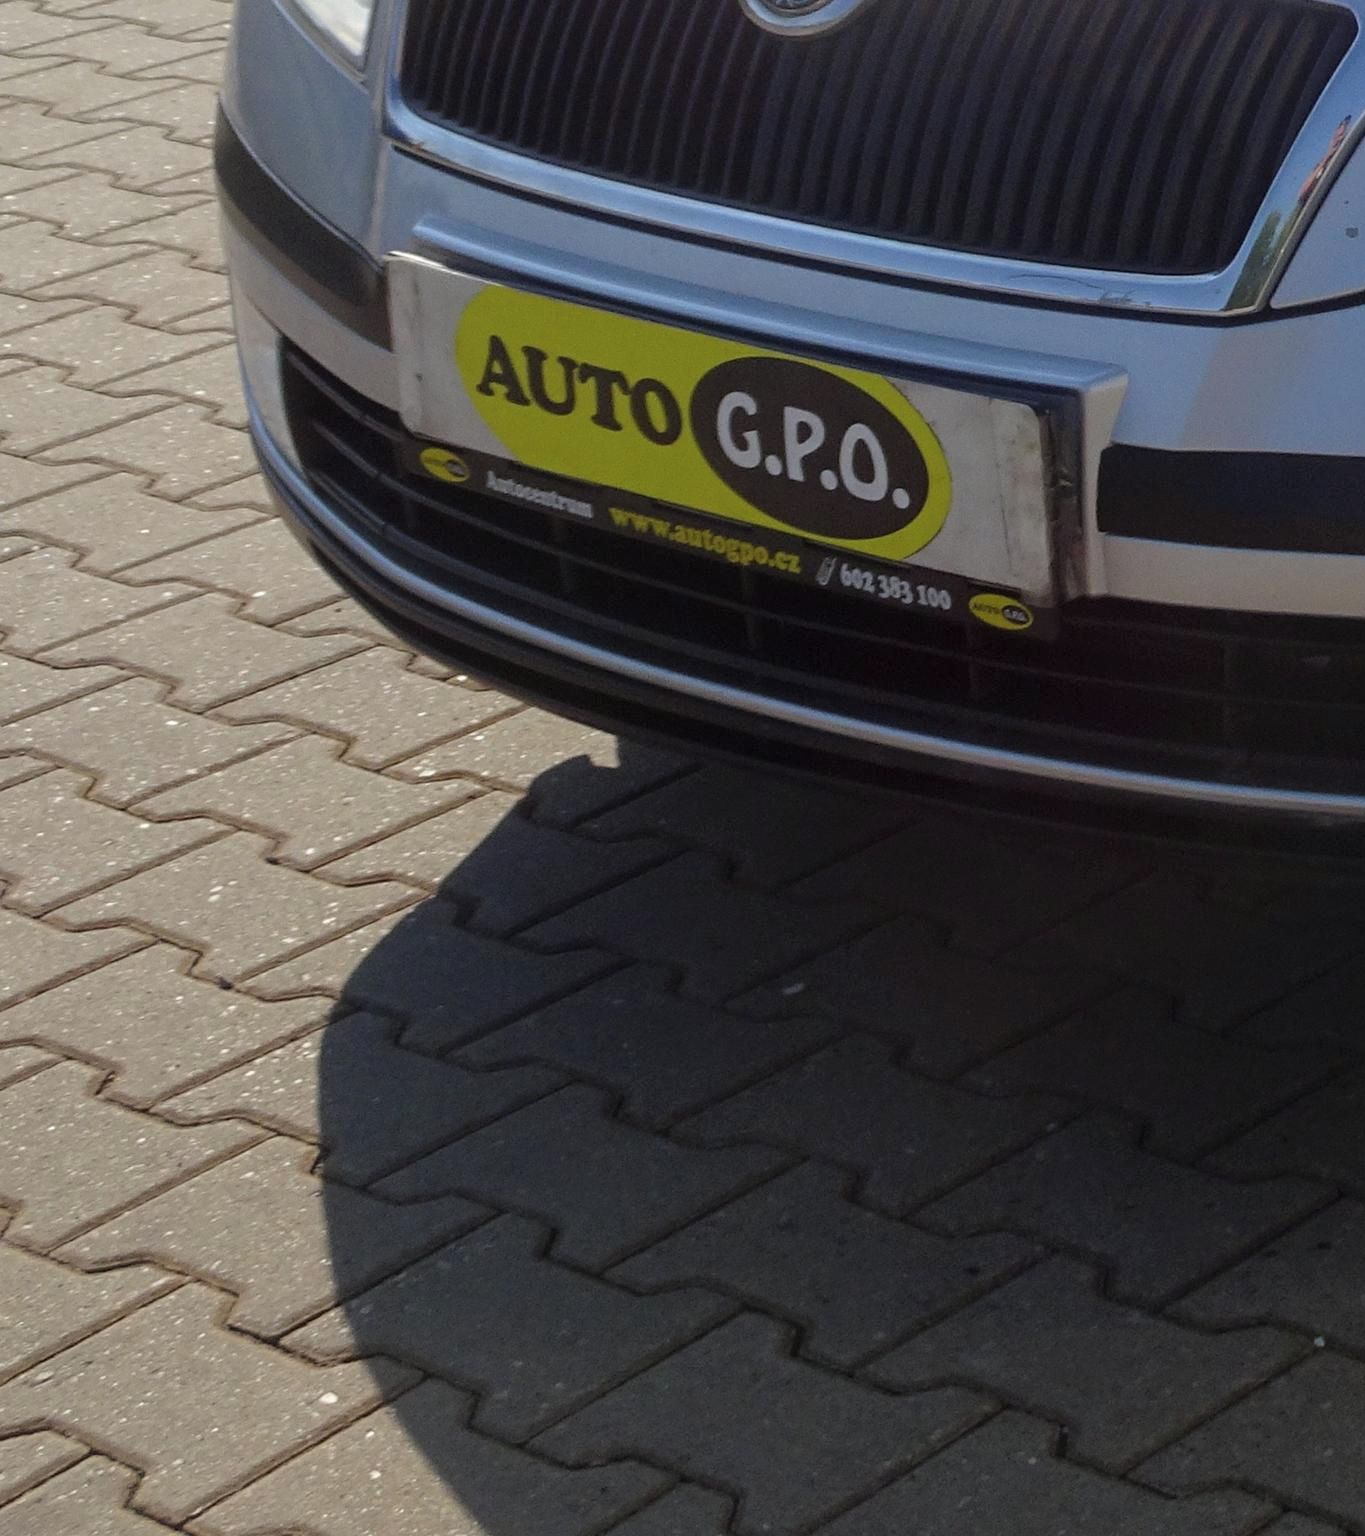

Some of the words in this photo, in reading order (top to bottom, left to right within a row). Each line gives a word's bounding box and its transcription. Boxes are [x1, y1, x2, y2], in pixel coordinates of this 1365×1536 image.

[476, 334, 683, 446] AUTO
[716, 390, 911, 510] G.P.O.
[486, 469, 593, 519] Autocentrum
[608, 507, 801, 574] www.autogpo.cz
[839, 562, 876, 594] 602
[877, 574, 914, 605] 383
[916, 584, 952, 611] 100
